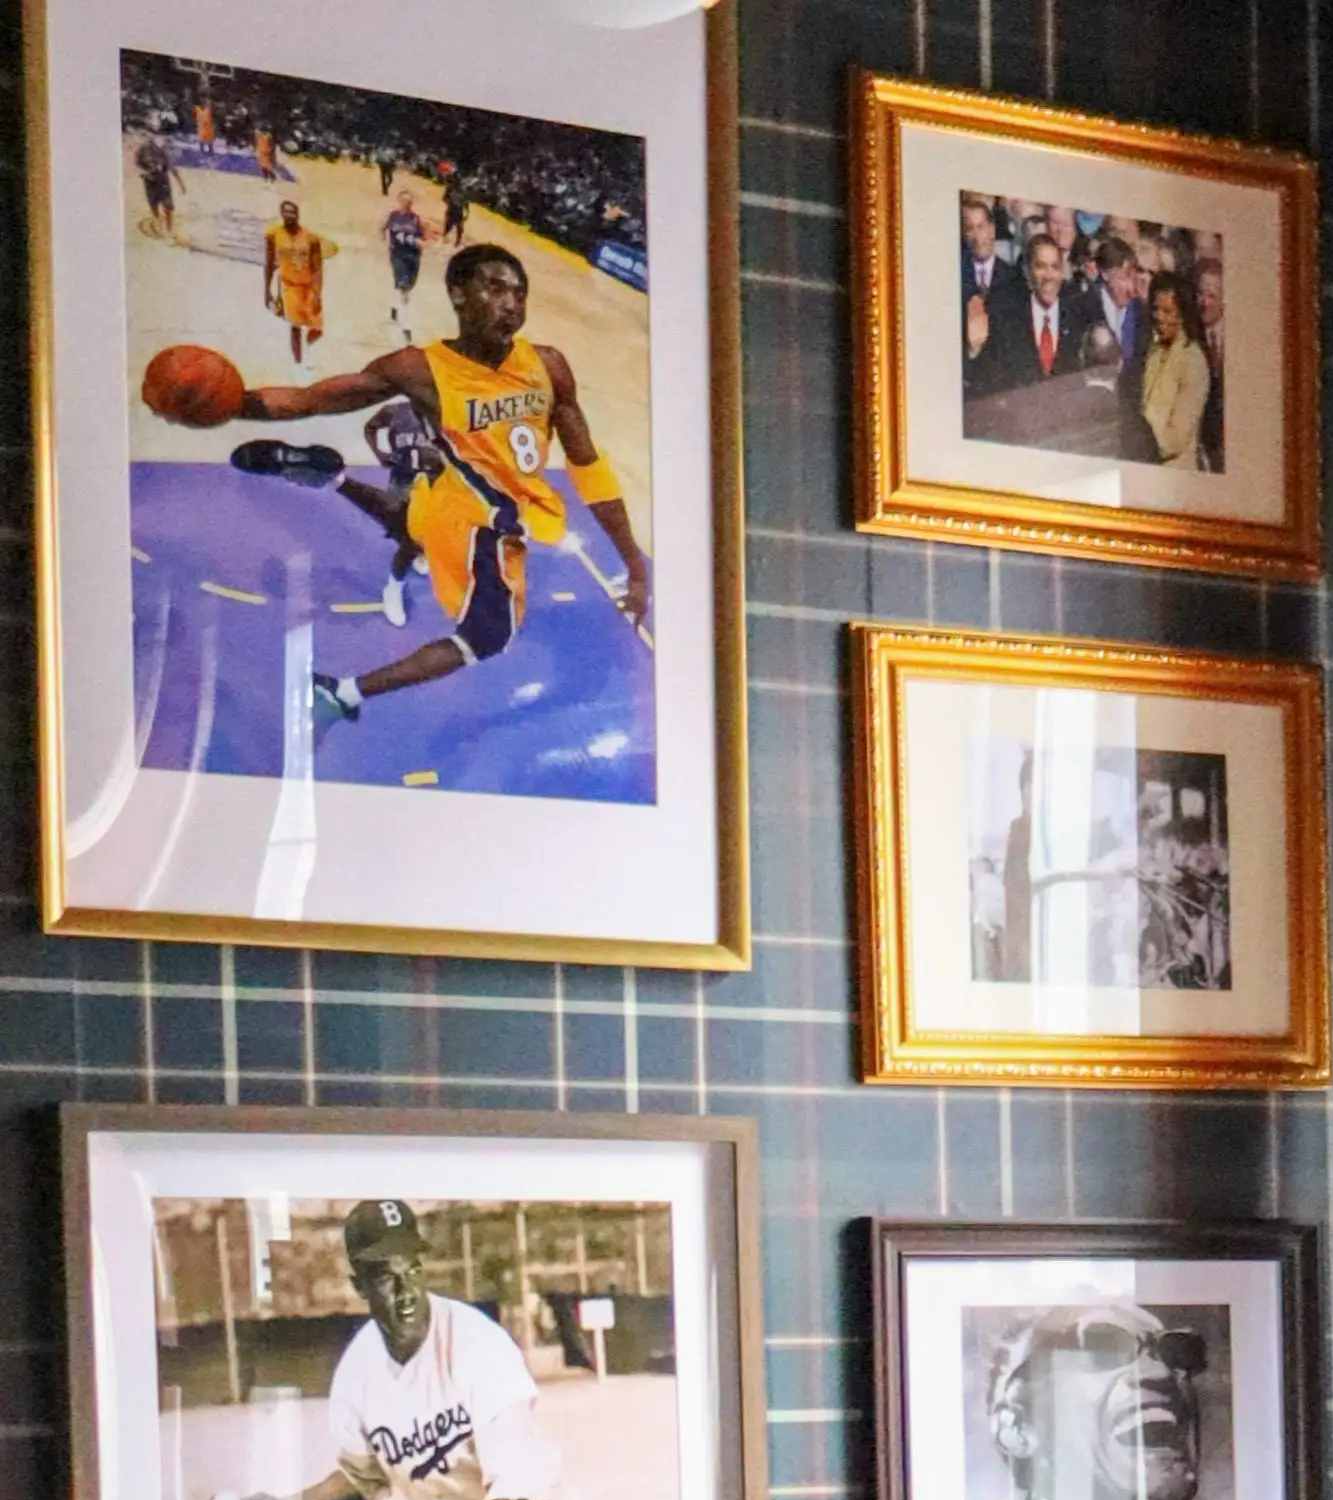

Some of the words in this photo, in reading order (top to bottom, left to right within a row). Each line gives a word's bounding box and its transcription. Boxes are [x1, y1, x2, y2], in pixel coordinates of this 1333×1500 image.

[465, 393, 549, 432] LAKERS
[508, 423, 541, 474] 8
[380, 1200, 402, 1228] B
[367, 1402, 472, 1468] Dodgers
